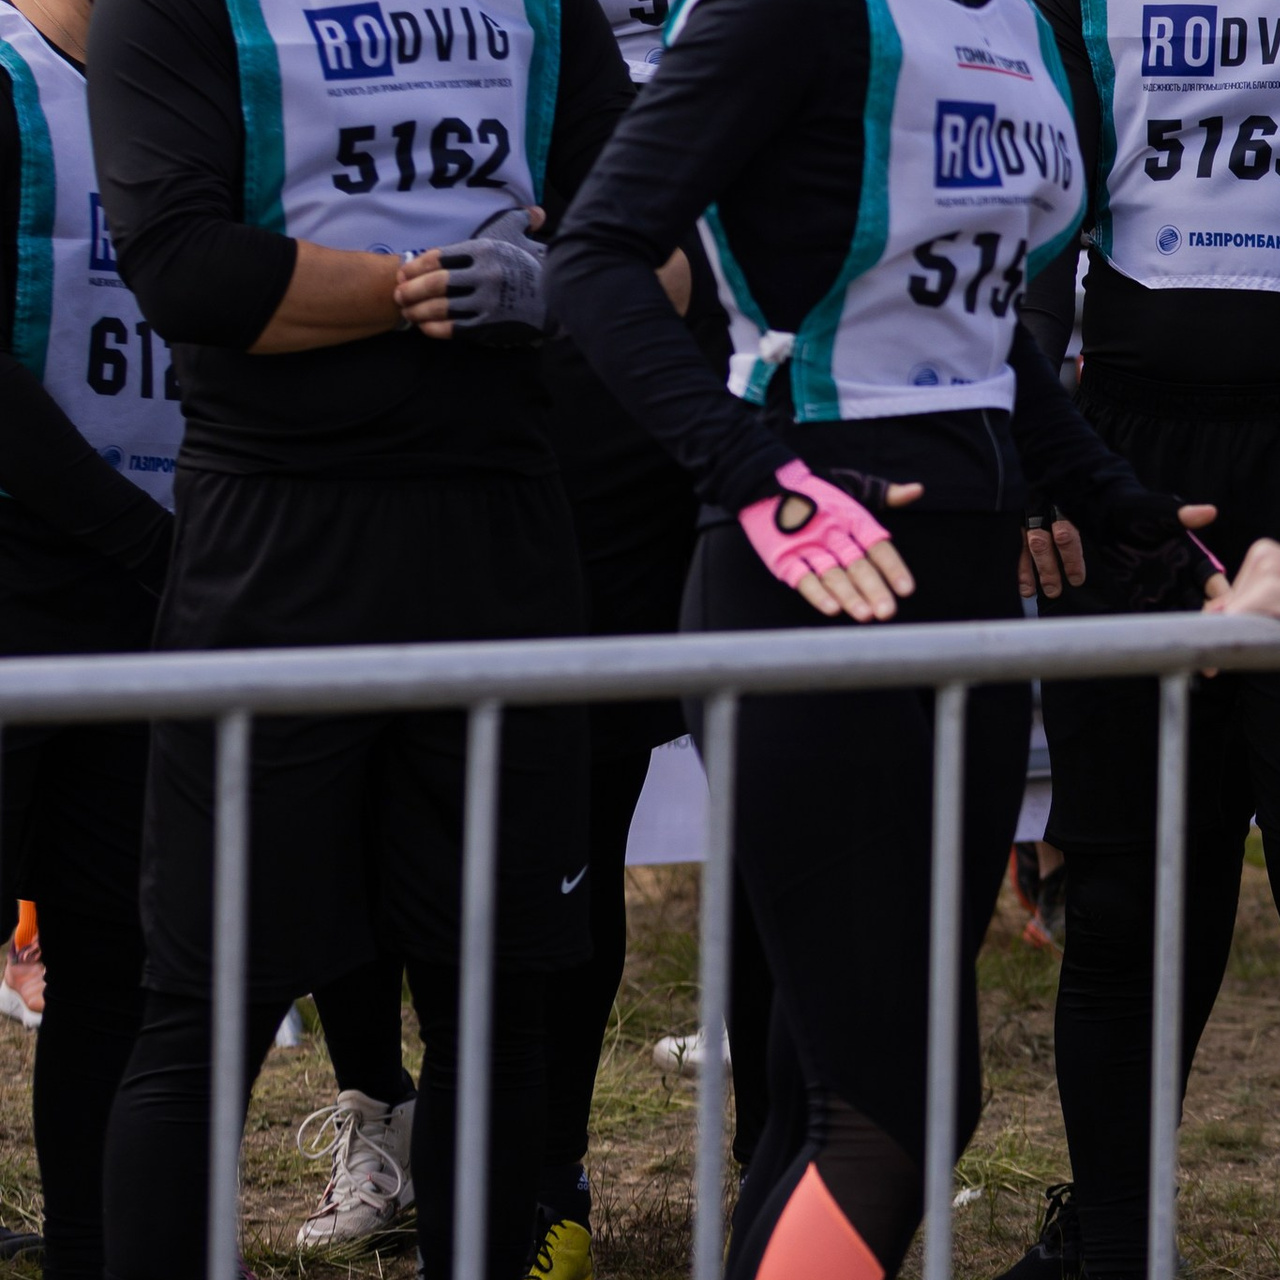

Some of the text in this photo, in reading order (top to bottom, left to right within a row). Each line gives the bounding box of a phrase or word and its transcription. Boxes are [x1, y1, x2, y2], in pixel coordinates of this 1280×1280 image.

[314, 6, 510, 71] RODVIG
[331, 116, 511, 195] 5162
[941, 111, 1073, 191] RODVIG
